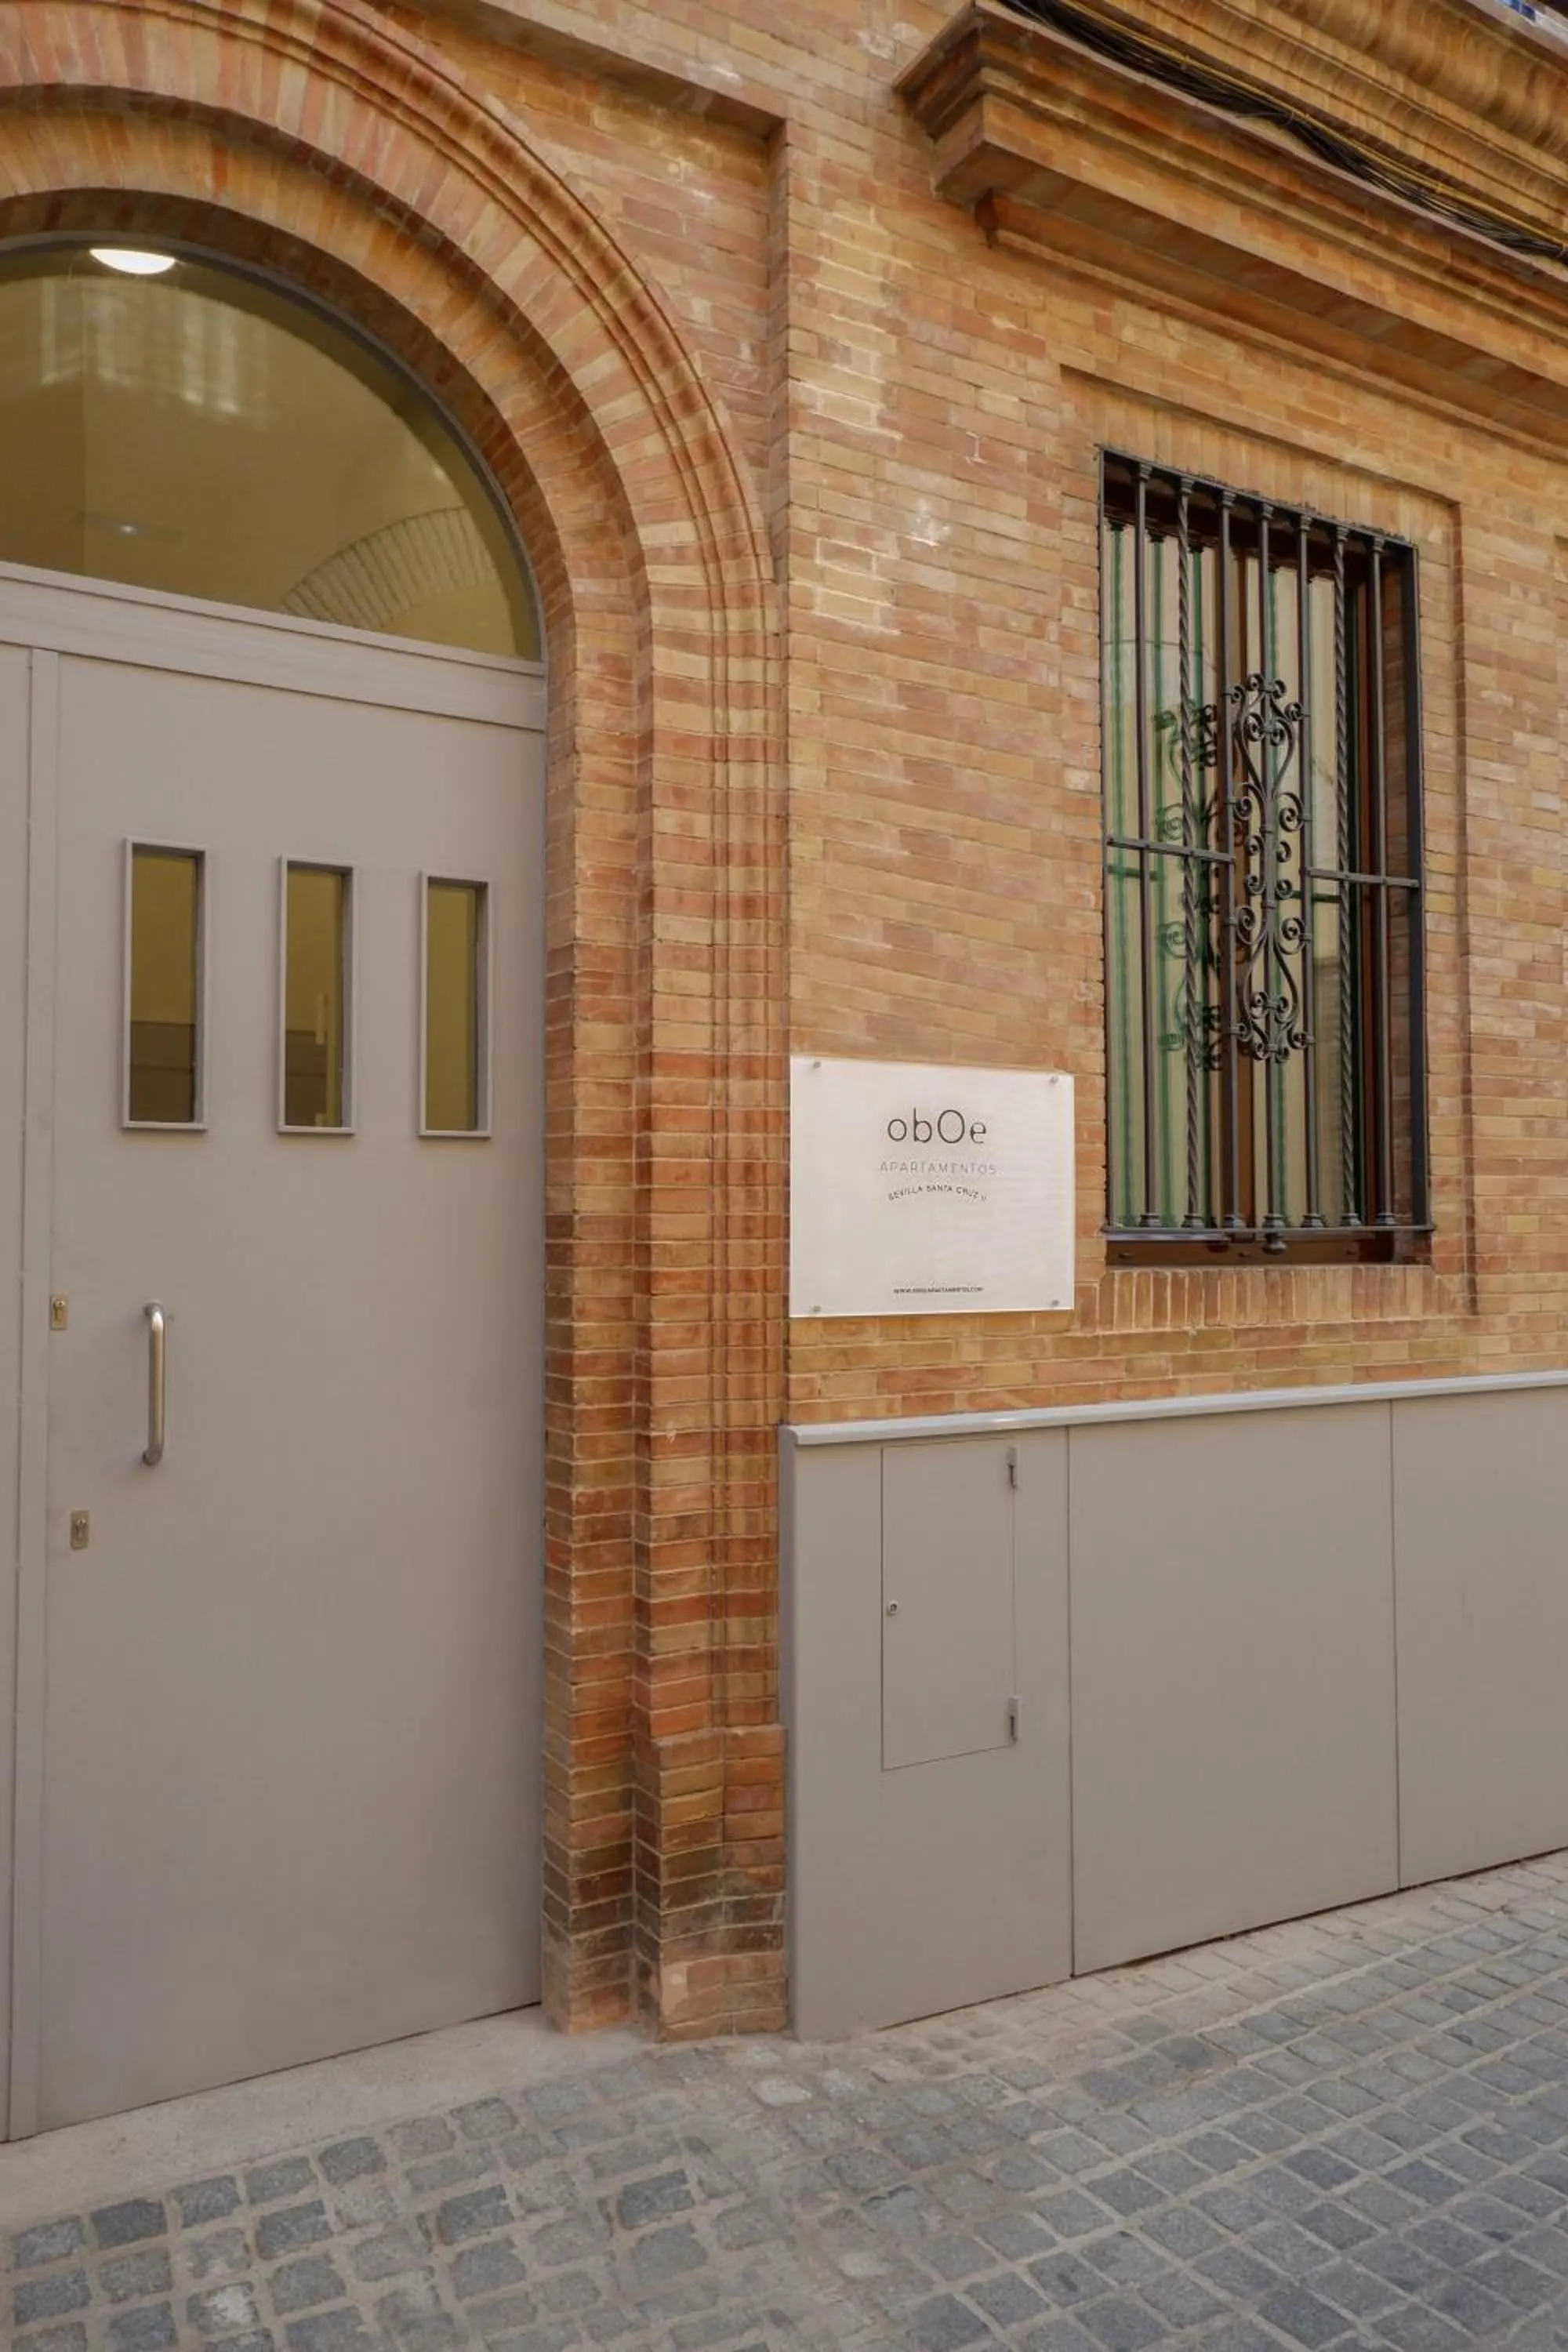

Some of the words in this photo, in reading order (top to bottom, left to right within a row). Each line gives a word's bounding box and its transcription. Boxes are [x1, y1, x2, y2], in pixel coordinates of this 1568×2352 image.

[887, 1107, 987, 1144] obOe
[880, 1161, 997, 1174] APARTAMENTOS
[888, 1185, 923, 1200] SEVILLA
[956, 1186, 979, 1198] CRUZ
